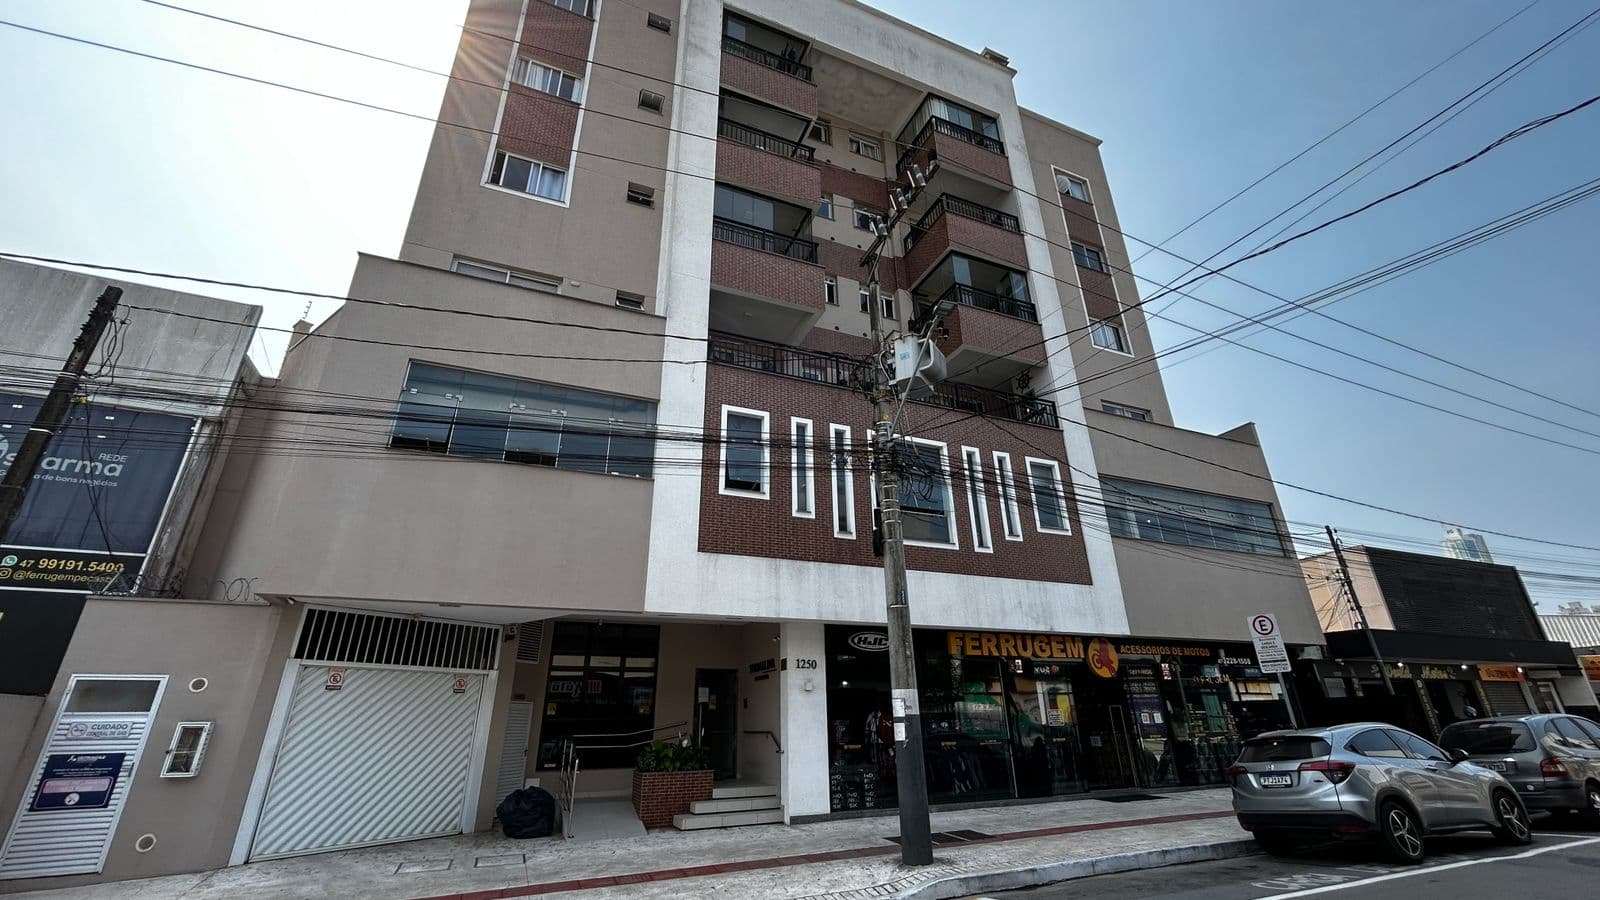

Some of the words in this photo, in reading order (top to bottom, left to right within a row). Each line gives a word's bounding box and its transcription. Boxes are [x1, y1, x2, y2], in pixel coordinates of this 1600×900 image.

[98, 452, 128, 463] REDE
[19, 559, 35, 568] 47
[1258, 619, 1269, 632] E
[946, 630, 1085, 658] FERRUGEM
[795, 658, 817, 669] 1250
